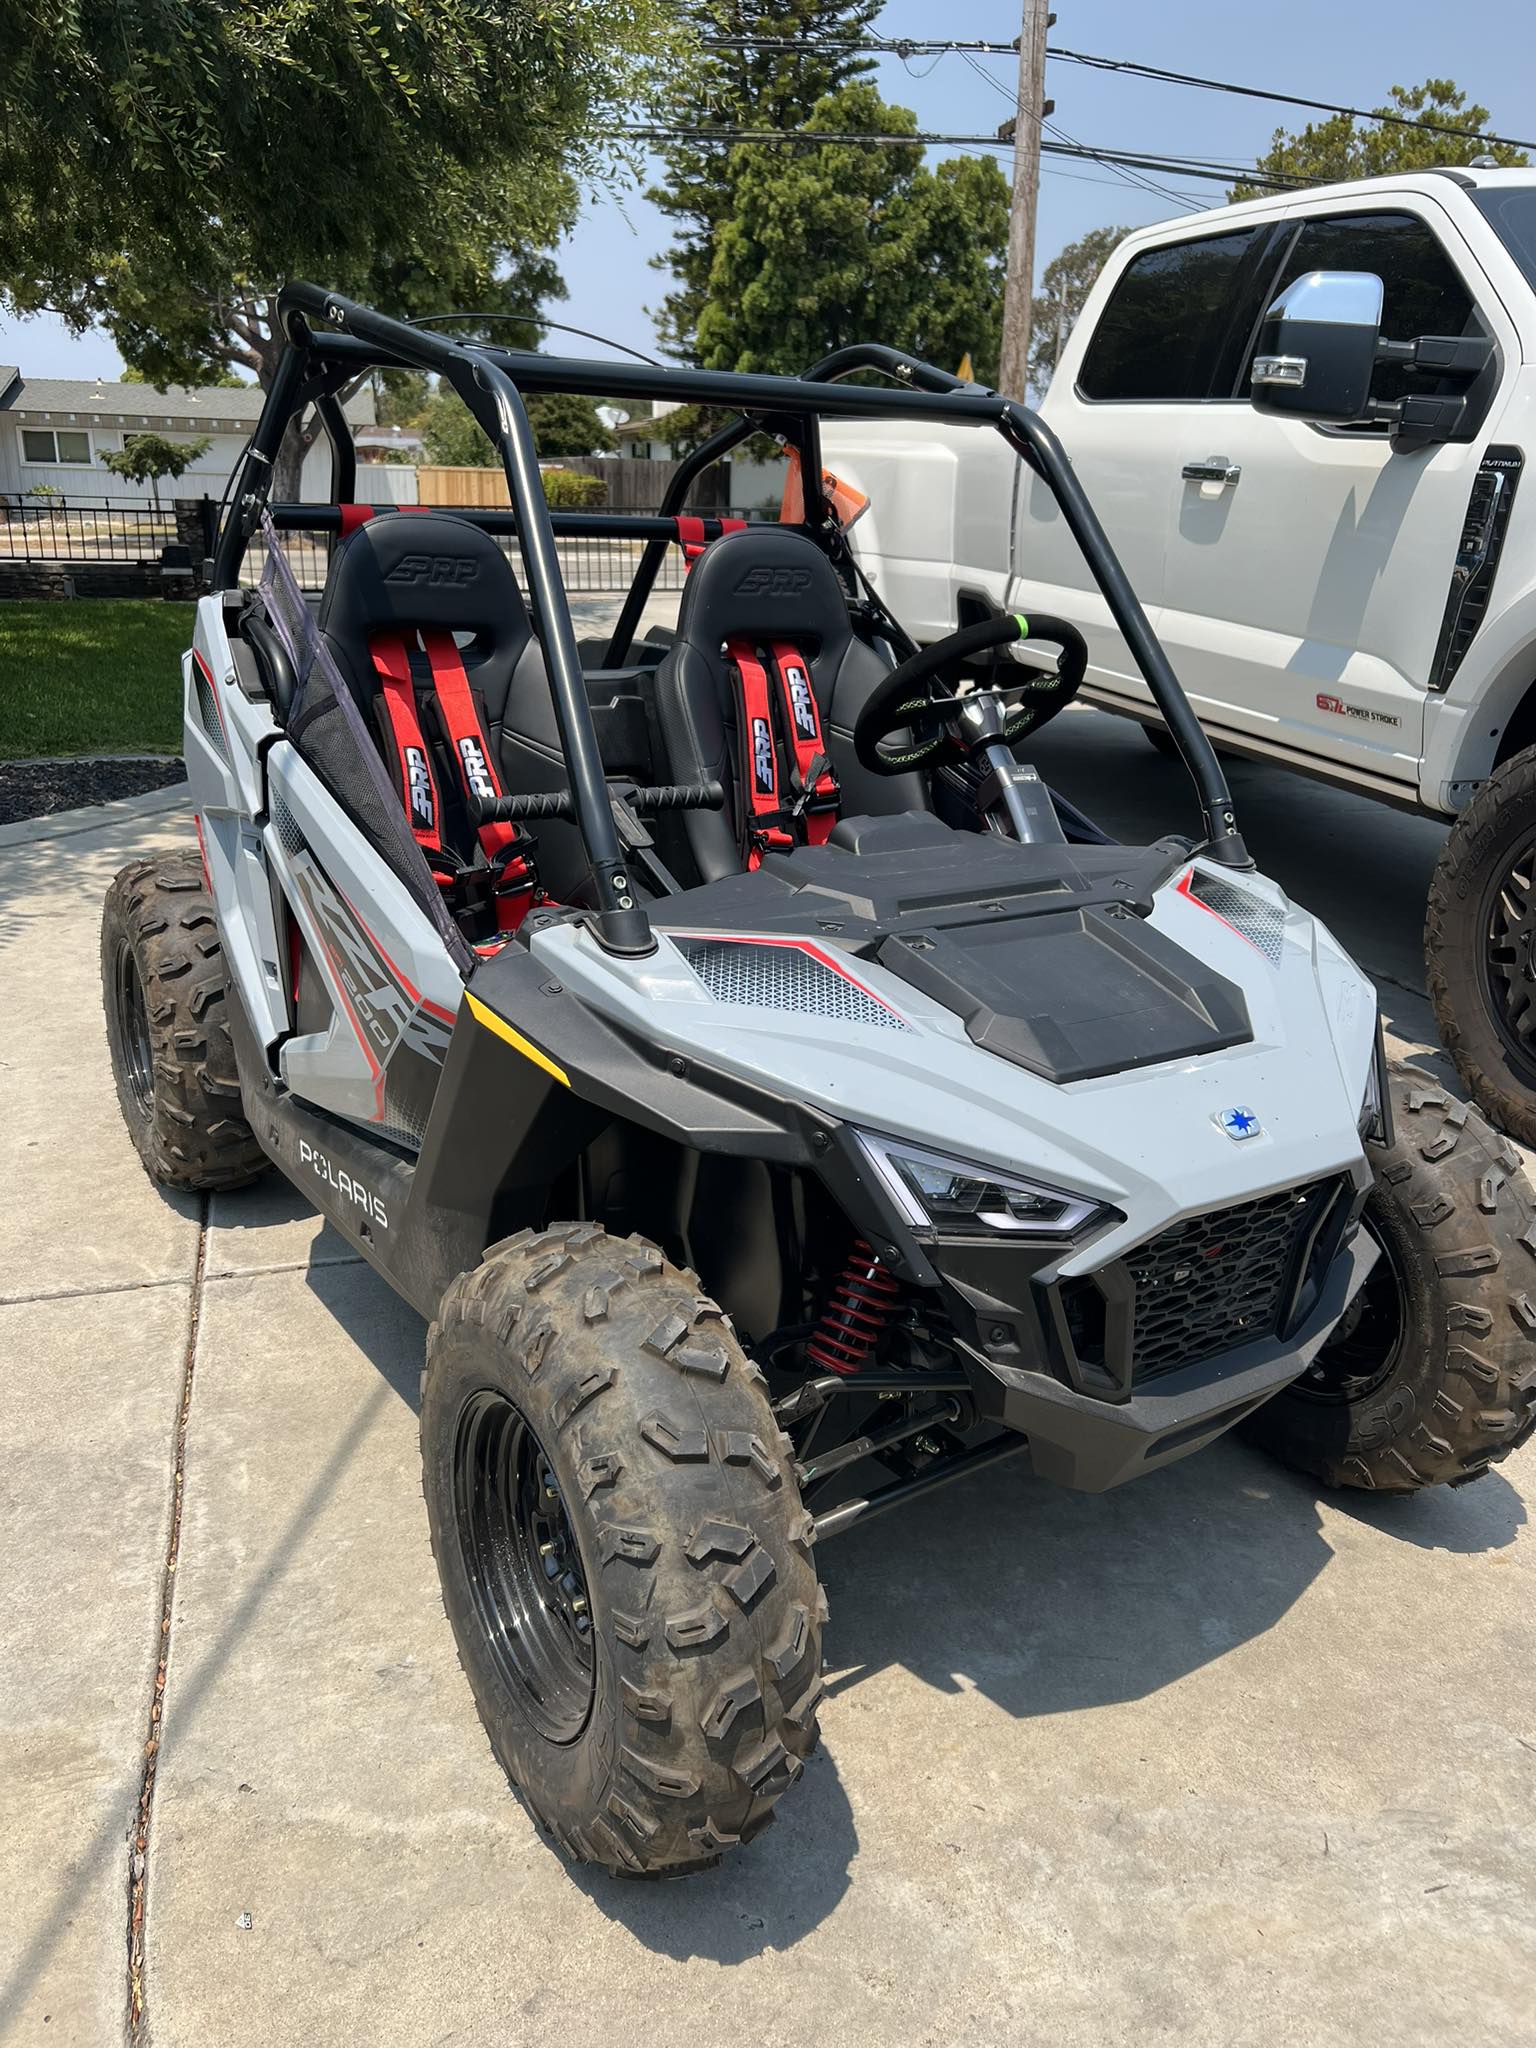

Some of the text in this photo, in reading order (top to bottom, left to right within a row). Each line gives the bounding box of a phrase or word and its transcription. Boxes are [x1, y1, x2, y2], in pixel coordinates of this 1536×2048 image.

[1346, 705, 1370, 718] POWER
[1371, 712, 1399, 726] STROKE
[289, 848, 450, 1067] RZR
[341, 968, 391, 1048] 200
[299, 1139, 388, 1228] POLARIS
